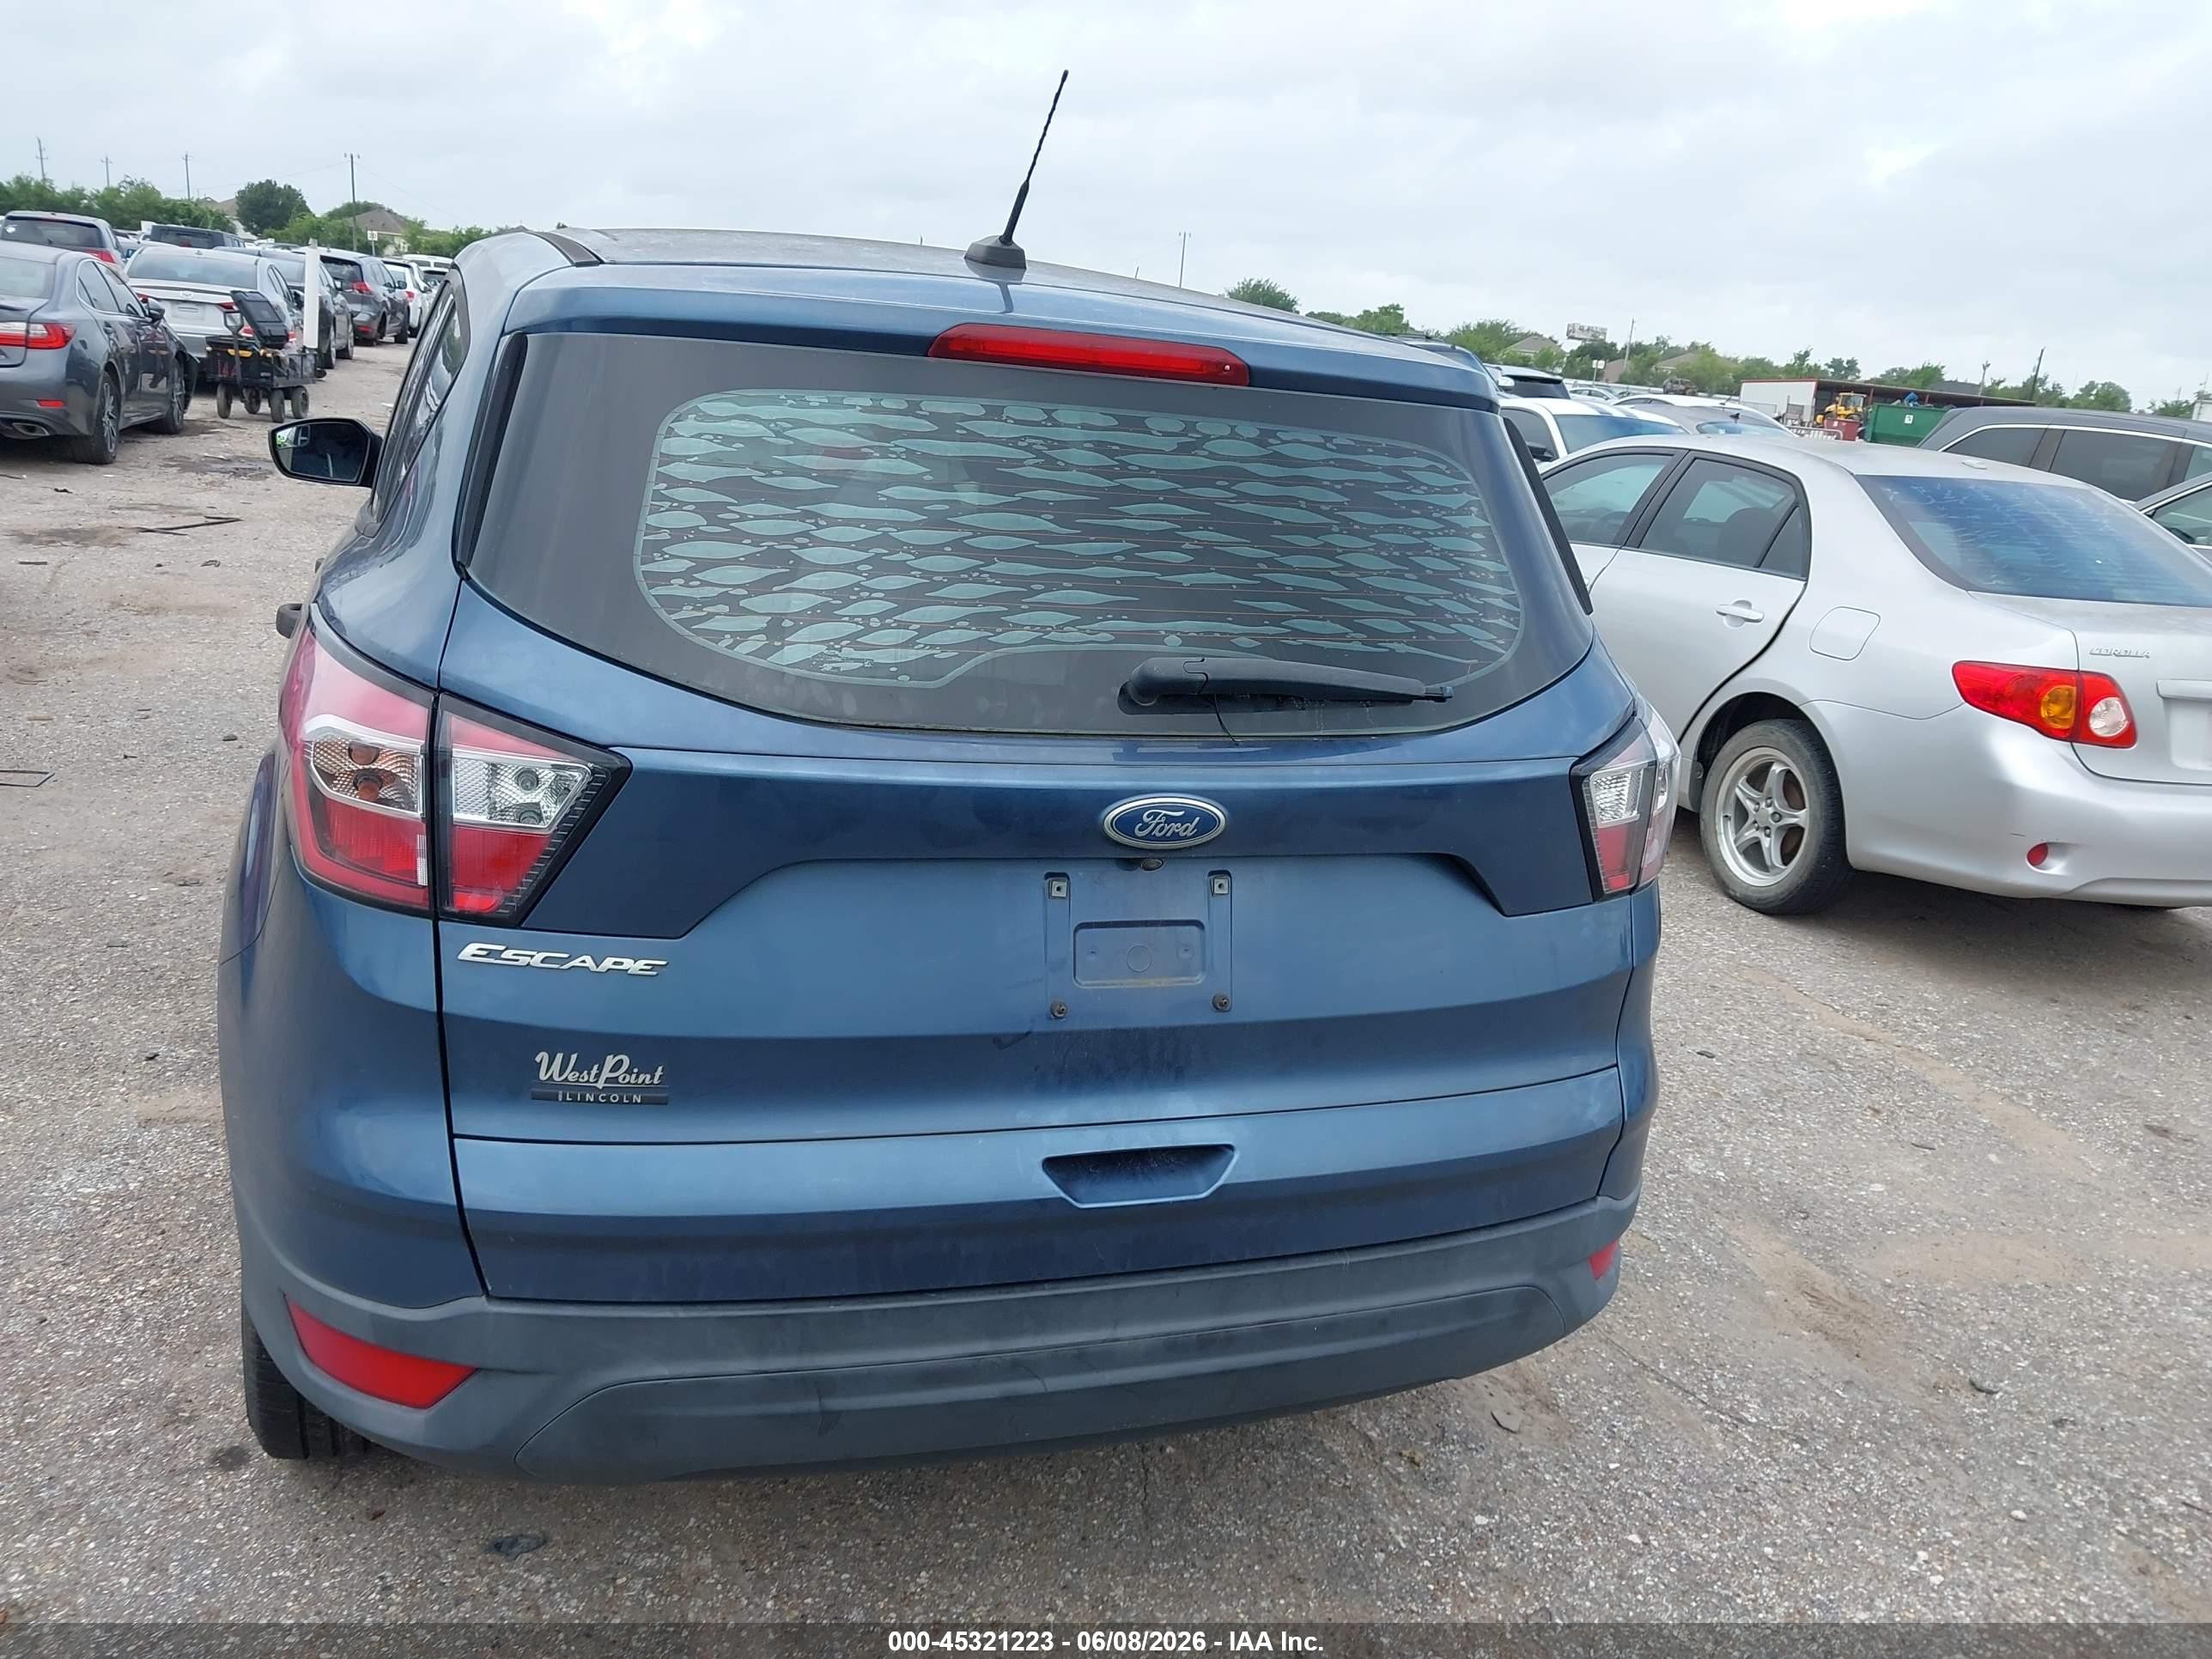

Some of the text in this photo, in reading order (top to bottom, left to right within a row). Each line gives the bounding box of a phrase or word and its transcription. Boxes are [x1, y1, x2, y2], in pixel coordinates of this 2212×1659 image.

[2088, 646, 2151, 659] COROLLA
[1134, 809, 1200, 838] Ford
[457, 942, 669, 976] ESCAPE
[566, 1090, 642, 1104] LINCOLN
